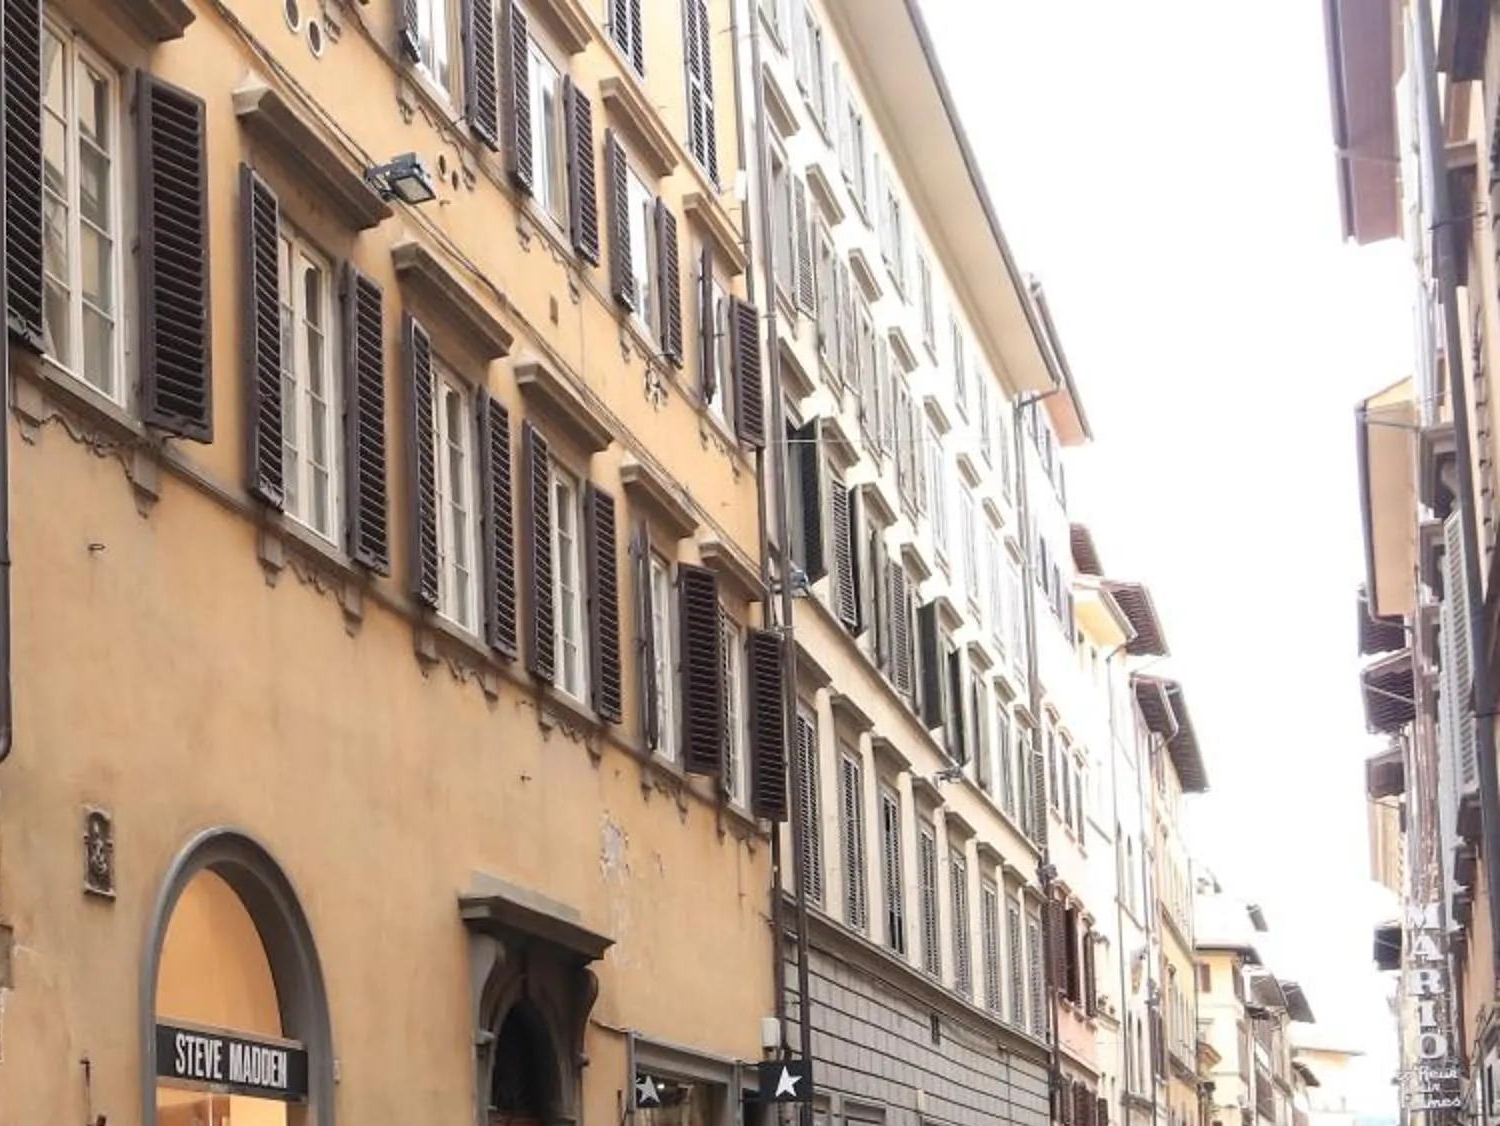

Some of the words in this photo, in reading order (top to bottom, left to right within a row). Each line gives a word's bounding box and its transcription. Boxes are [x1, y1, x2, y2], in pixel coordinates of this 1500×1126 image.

[1407, 901, 1448, 1059] MARIO
[175, 1032, 222, 1080] STEVE
[229, 1043, 287, 1088] MADDEN
